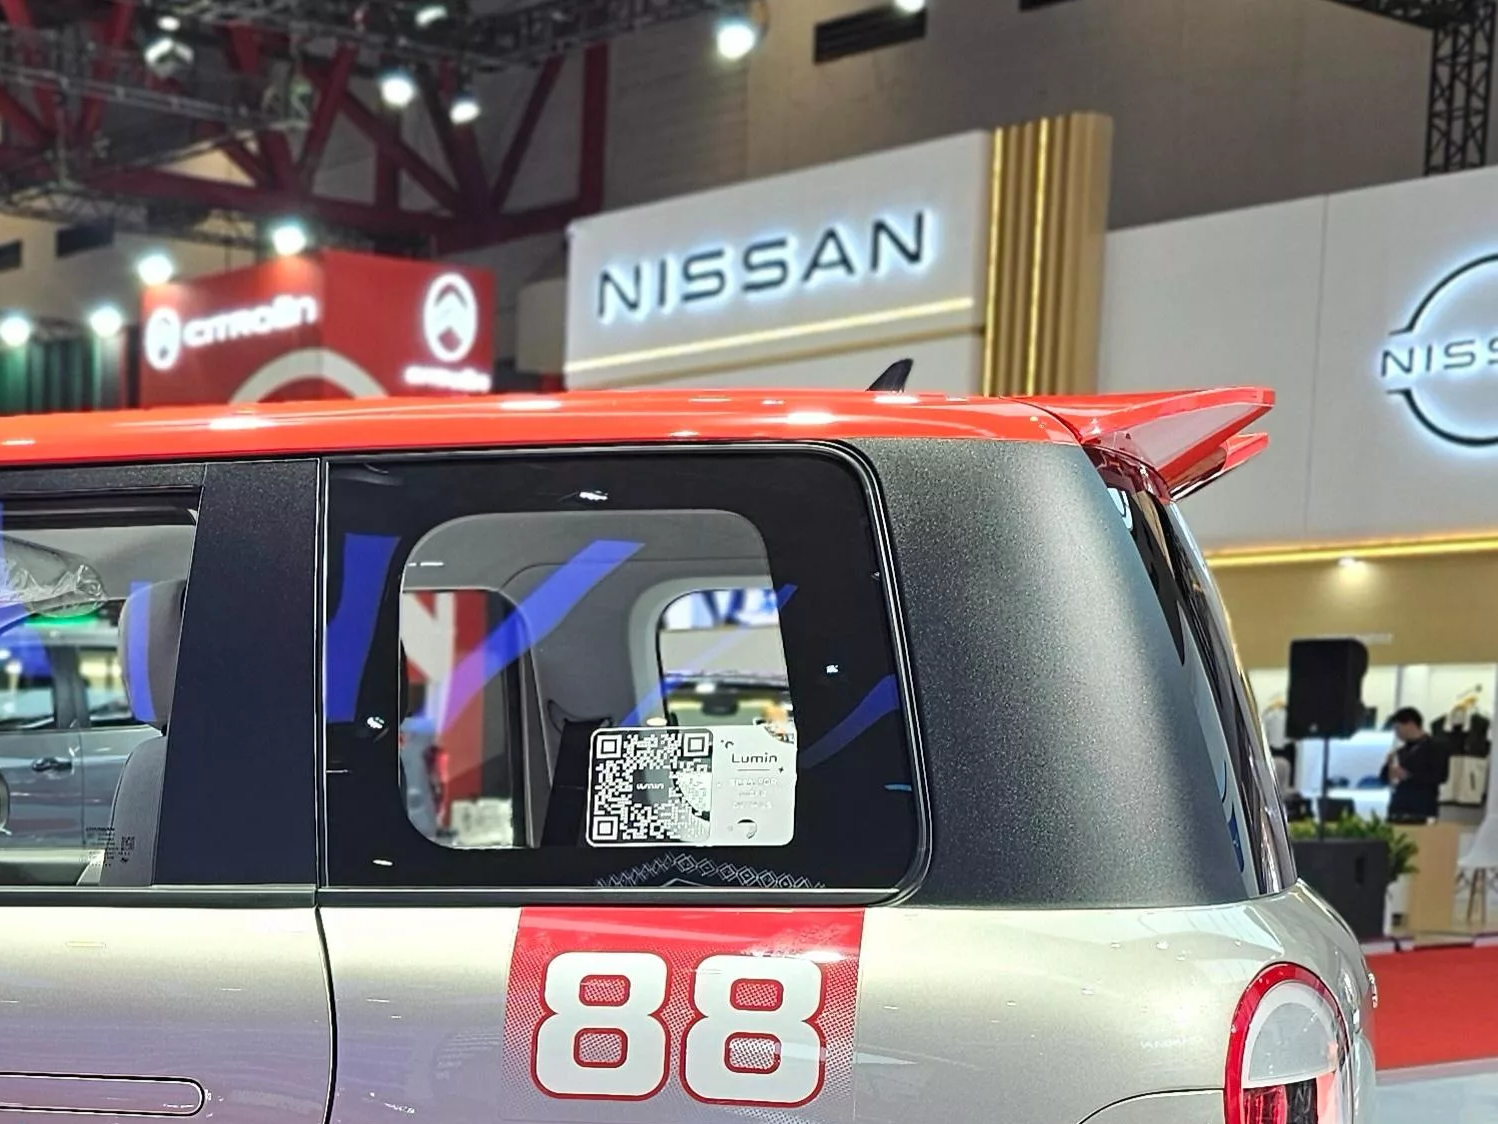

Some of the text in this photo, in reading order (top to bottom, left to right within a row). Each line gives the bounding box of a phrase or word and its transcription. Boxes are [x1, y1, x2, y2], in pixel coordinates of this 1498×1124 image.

[598, 211, 925, 318] NISSAN
[731, 753, 778, 764] Lumin
[530, 950, 827, 1108] 88
